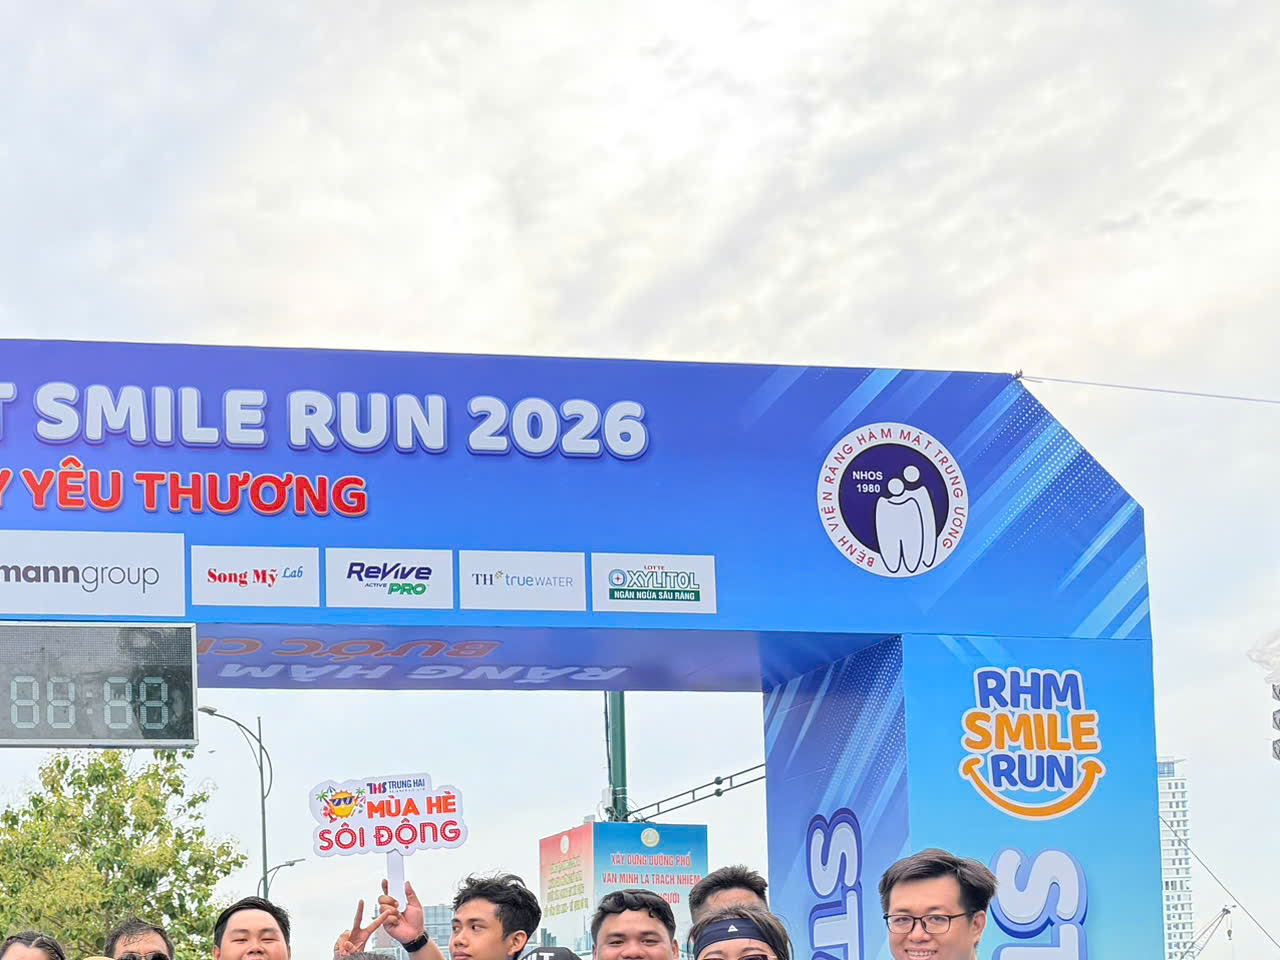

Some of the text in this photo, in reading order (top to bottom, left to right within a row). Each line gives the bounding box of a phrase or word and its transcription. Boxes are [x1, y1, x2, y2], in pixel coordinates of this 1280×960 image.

[35, 381, 266, 449] SMILE
[288, 390, 448, 454] RUN
[467, 396, 648, 459] 2026
[856, 428, 892, 446] HÀM
[21, 456, 122, 512] YÊU
[135, 471, 369, 517] THƯƠNG
[852, 470, 883, 481] NHOS
[856, 483, 881, 493] 1980
[933, 448, 965, 499] TRUNG
[942, 506, 966, 550] ƯƠNG
[207, 565, 304, 588] Song Mỹ Lab
[387, 582, 427, 596] PRO
[472, 573, 495, 586] TH
[976, 669, 1083, 710] RHM
[962, 711, 1099, 751] SMILE
[388, 779, 412, 790] TRUNG
[413, 778, 425, 788] HAI
[990, 753, 1074, 790] RUN
[367, 790, 457, 819] MÙA HÈ
[319, 817, 462, 851] SÔI ĐỘNG
[620, 872, 639, 884] MINH
